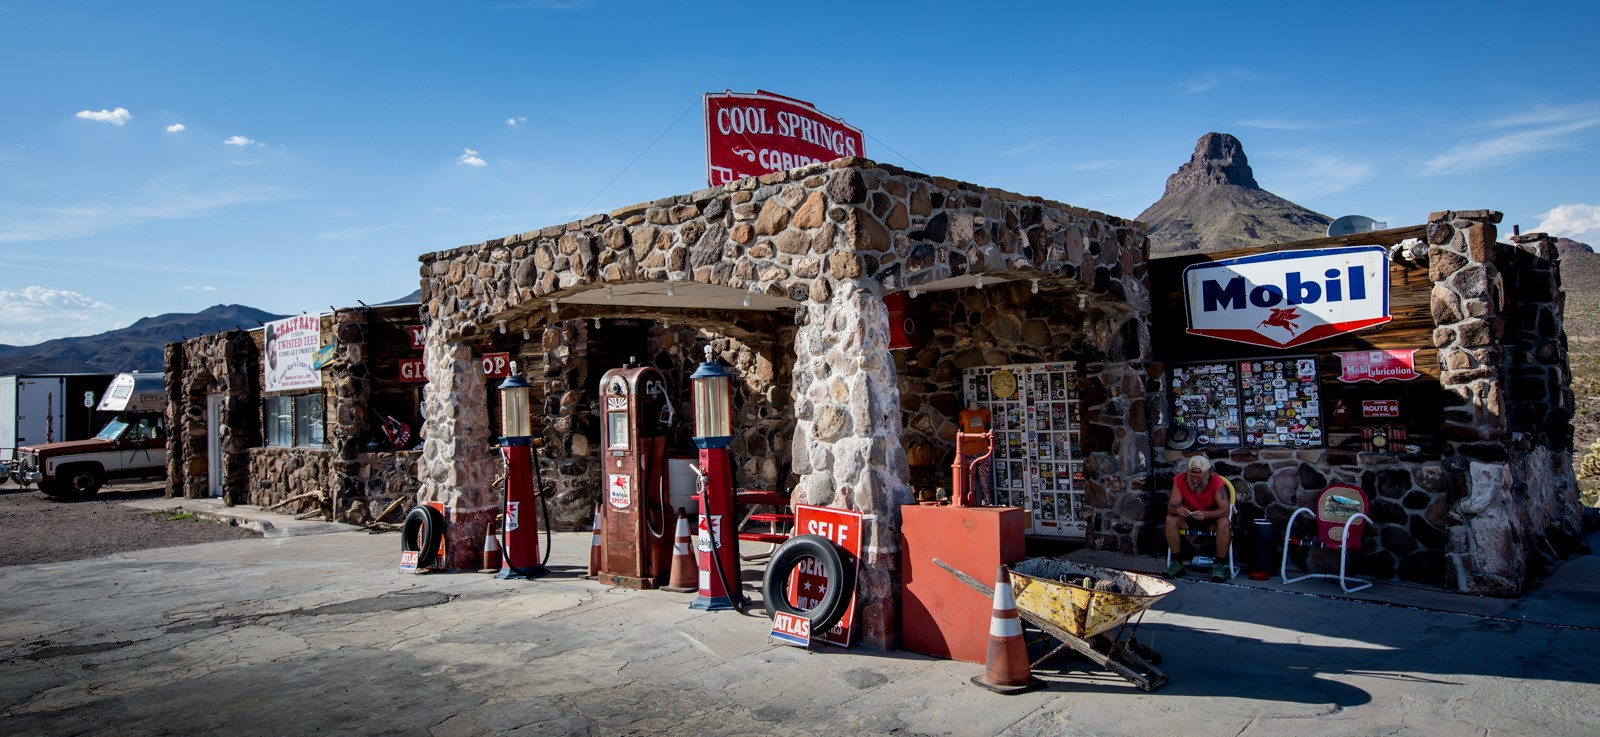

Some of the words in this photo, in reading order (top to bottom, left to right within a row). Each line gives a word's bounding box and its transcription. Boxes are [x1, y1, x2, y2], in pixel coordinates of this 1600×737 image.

[717, 107, 773, 135] COOL
[777, 111, 857, 157] SPRINGS
[1202, 265, 1366, 312] Mobil
[276, 318, 298, 339] CRAZY
[300, 317, 319, 332] RAY'S
[278, 337, 303, 350] TWISTED
[303, 335, 318, 346] TEES
[279, 350, 290, 358] COME
[611, 496, 629, 505] SPECIAL
[401, 552, 418, 564] ATLAS
[773, 615, 809, 636] ATLAS
